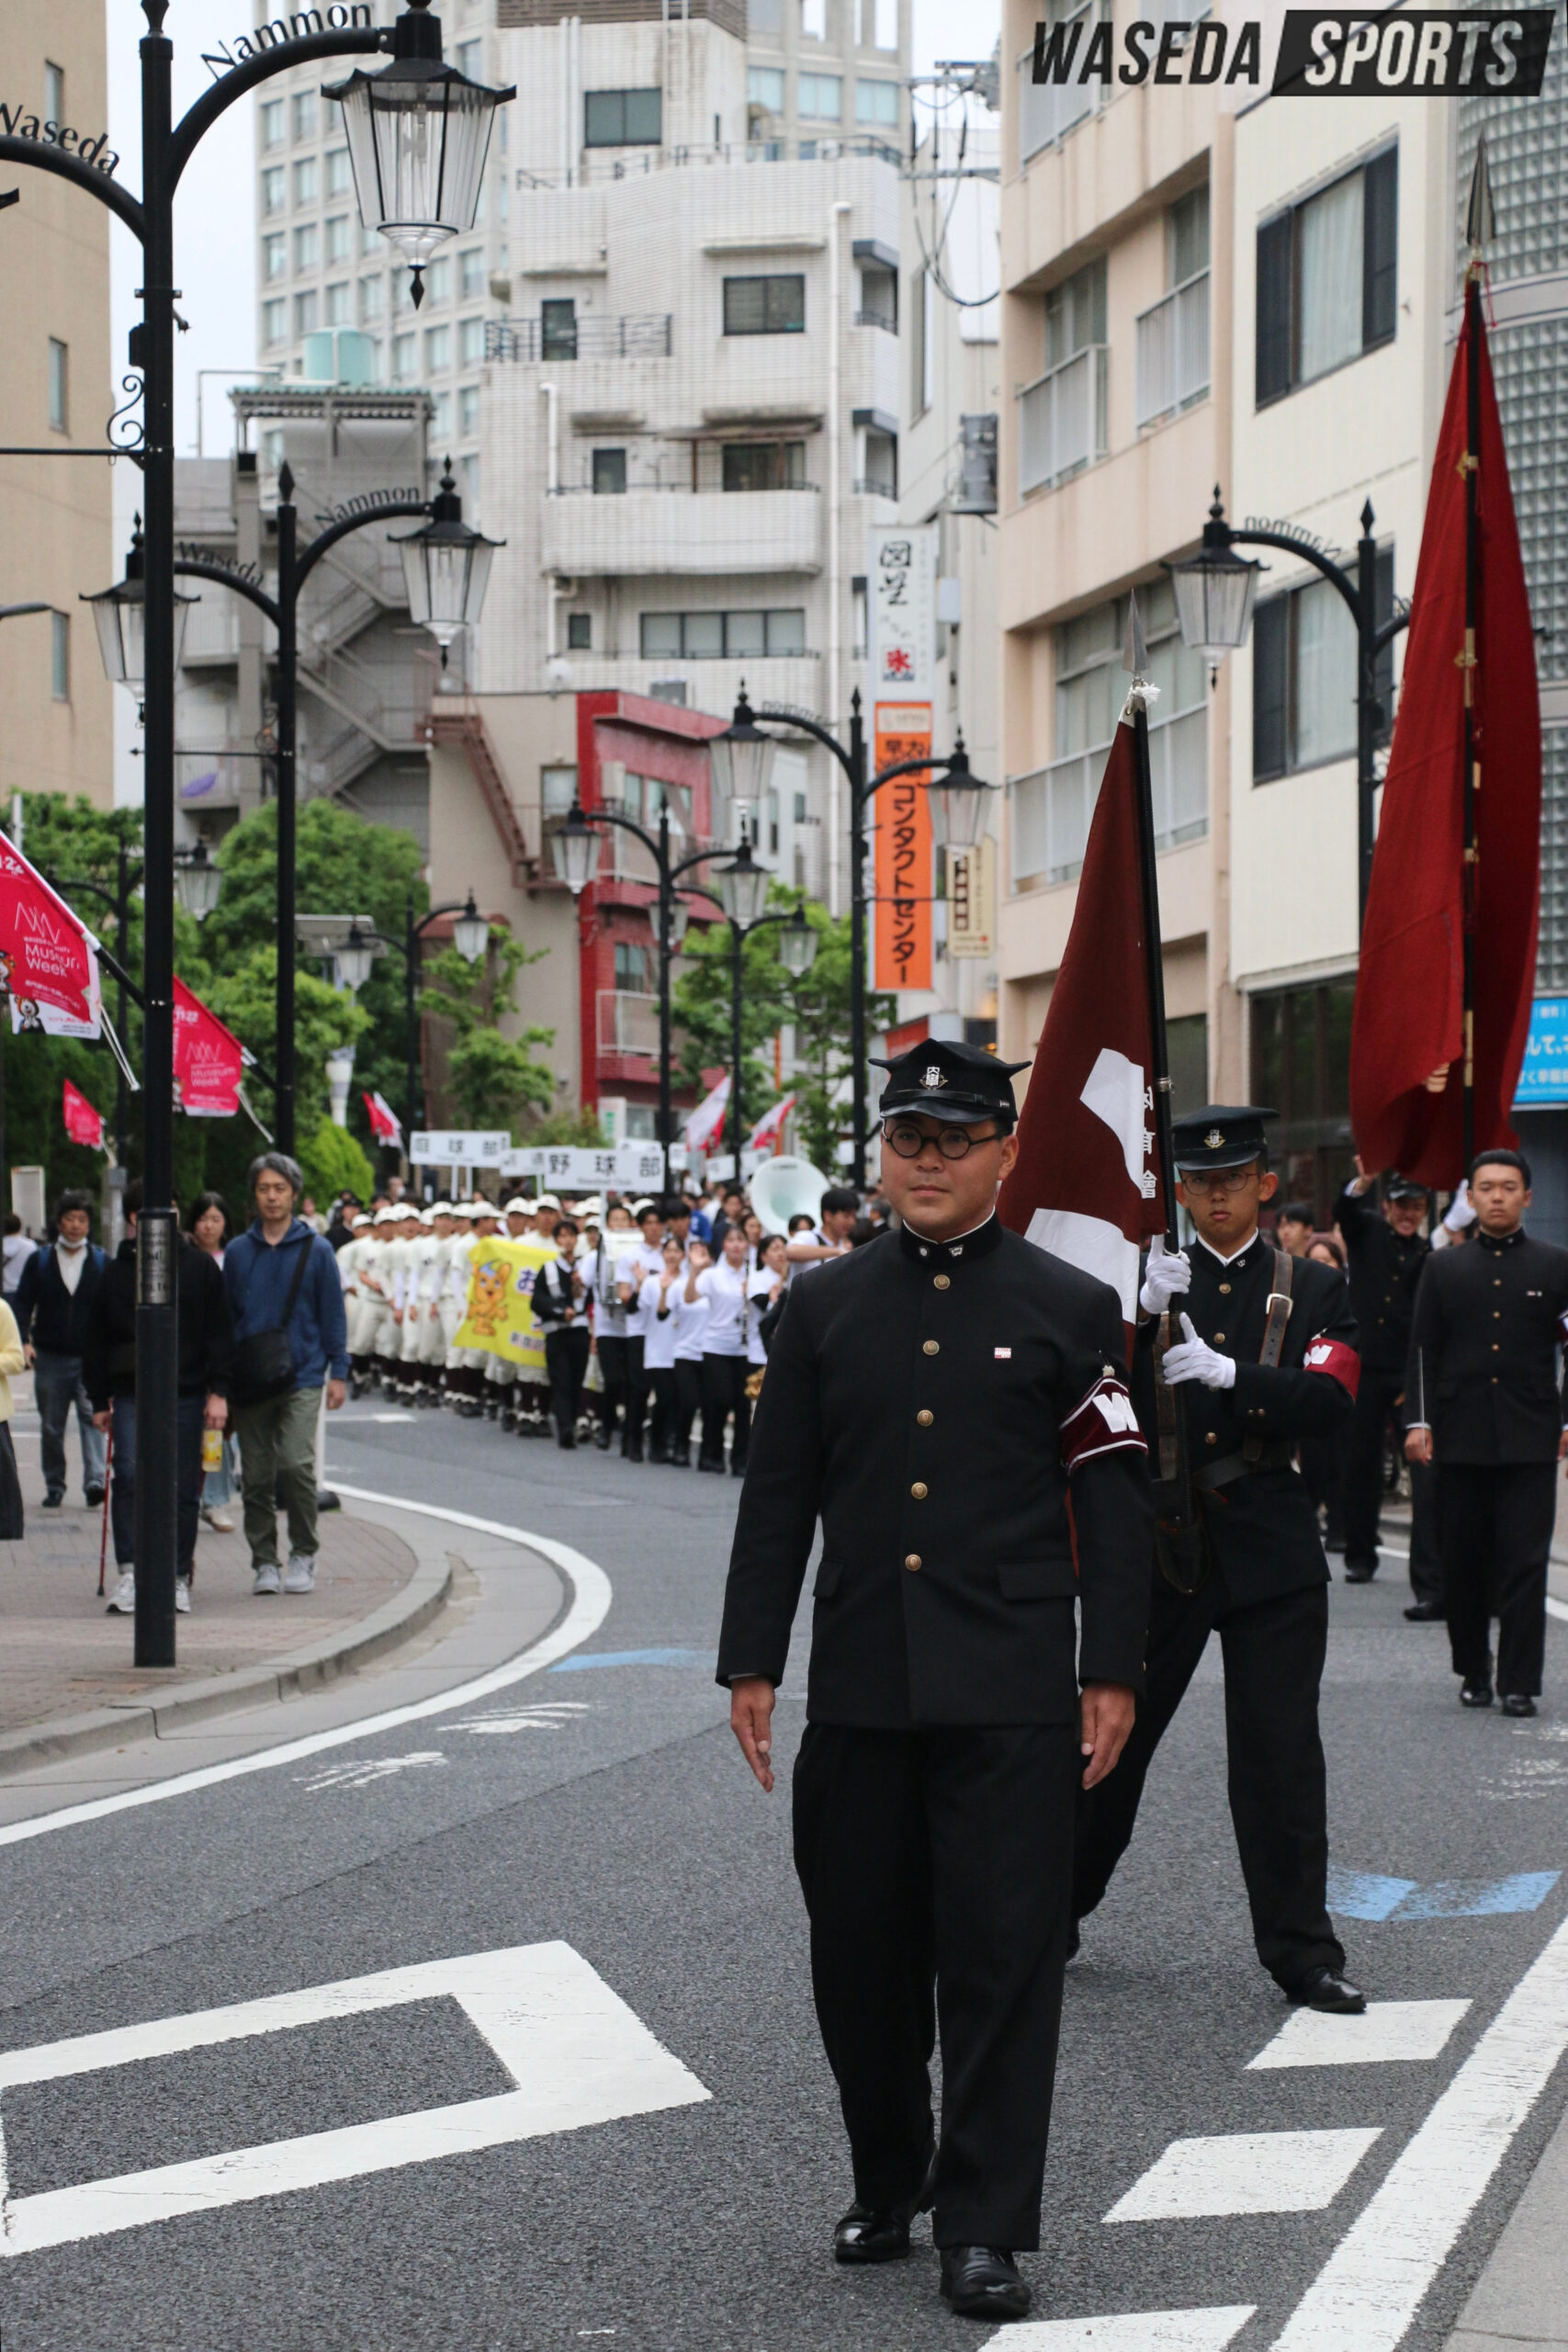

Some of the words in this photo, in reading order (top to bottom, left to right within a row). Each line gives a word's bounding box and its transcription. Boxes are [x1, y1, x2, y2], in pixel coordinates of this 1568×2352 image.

[201, 4, 372, 81] Nammon
[315, 486, 420, 530] Nammon
[179, 541, 265, 588] Waseda
[892, 784, 916, 984] コンタクトセンター
[26, 956, 67, 978] Week
[548, 1154, 660, 1178] 野球部
[1092, 1392, 1140, 1433] W
